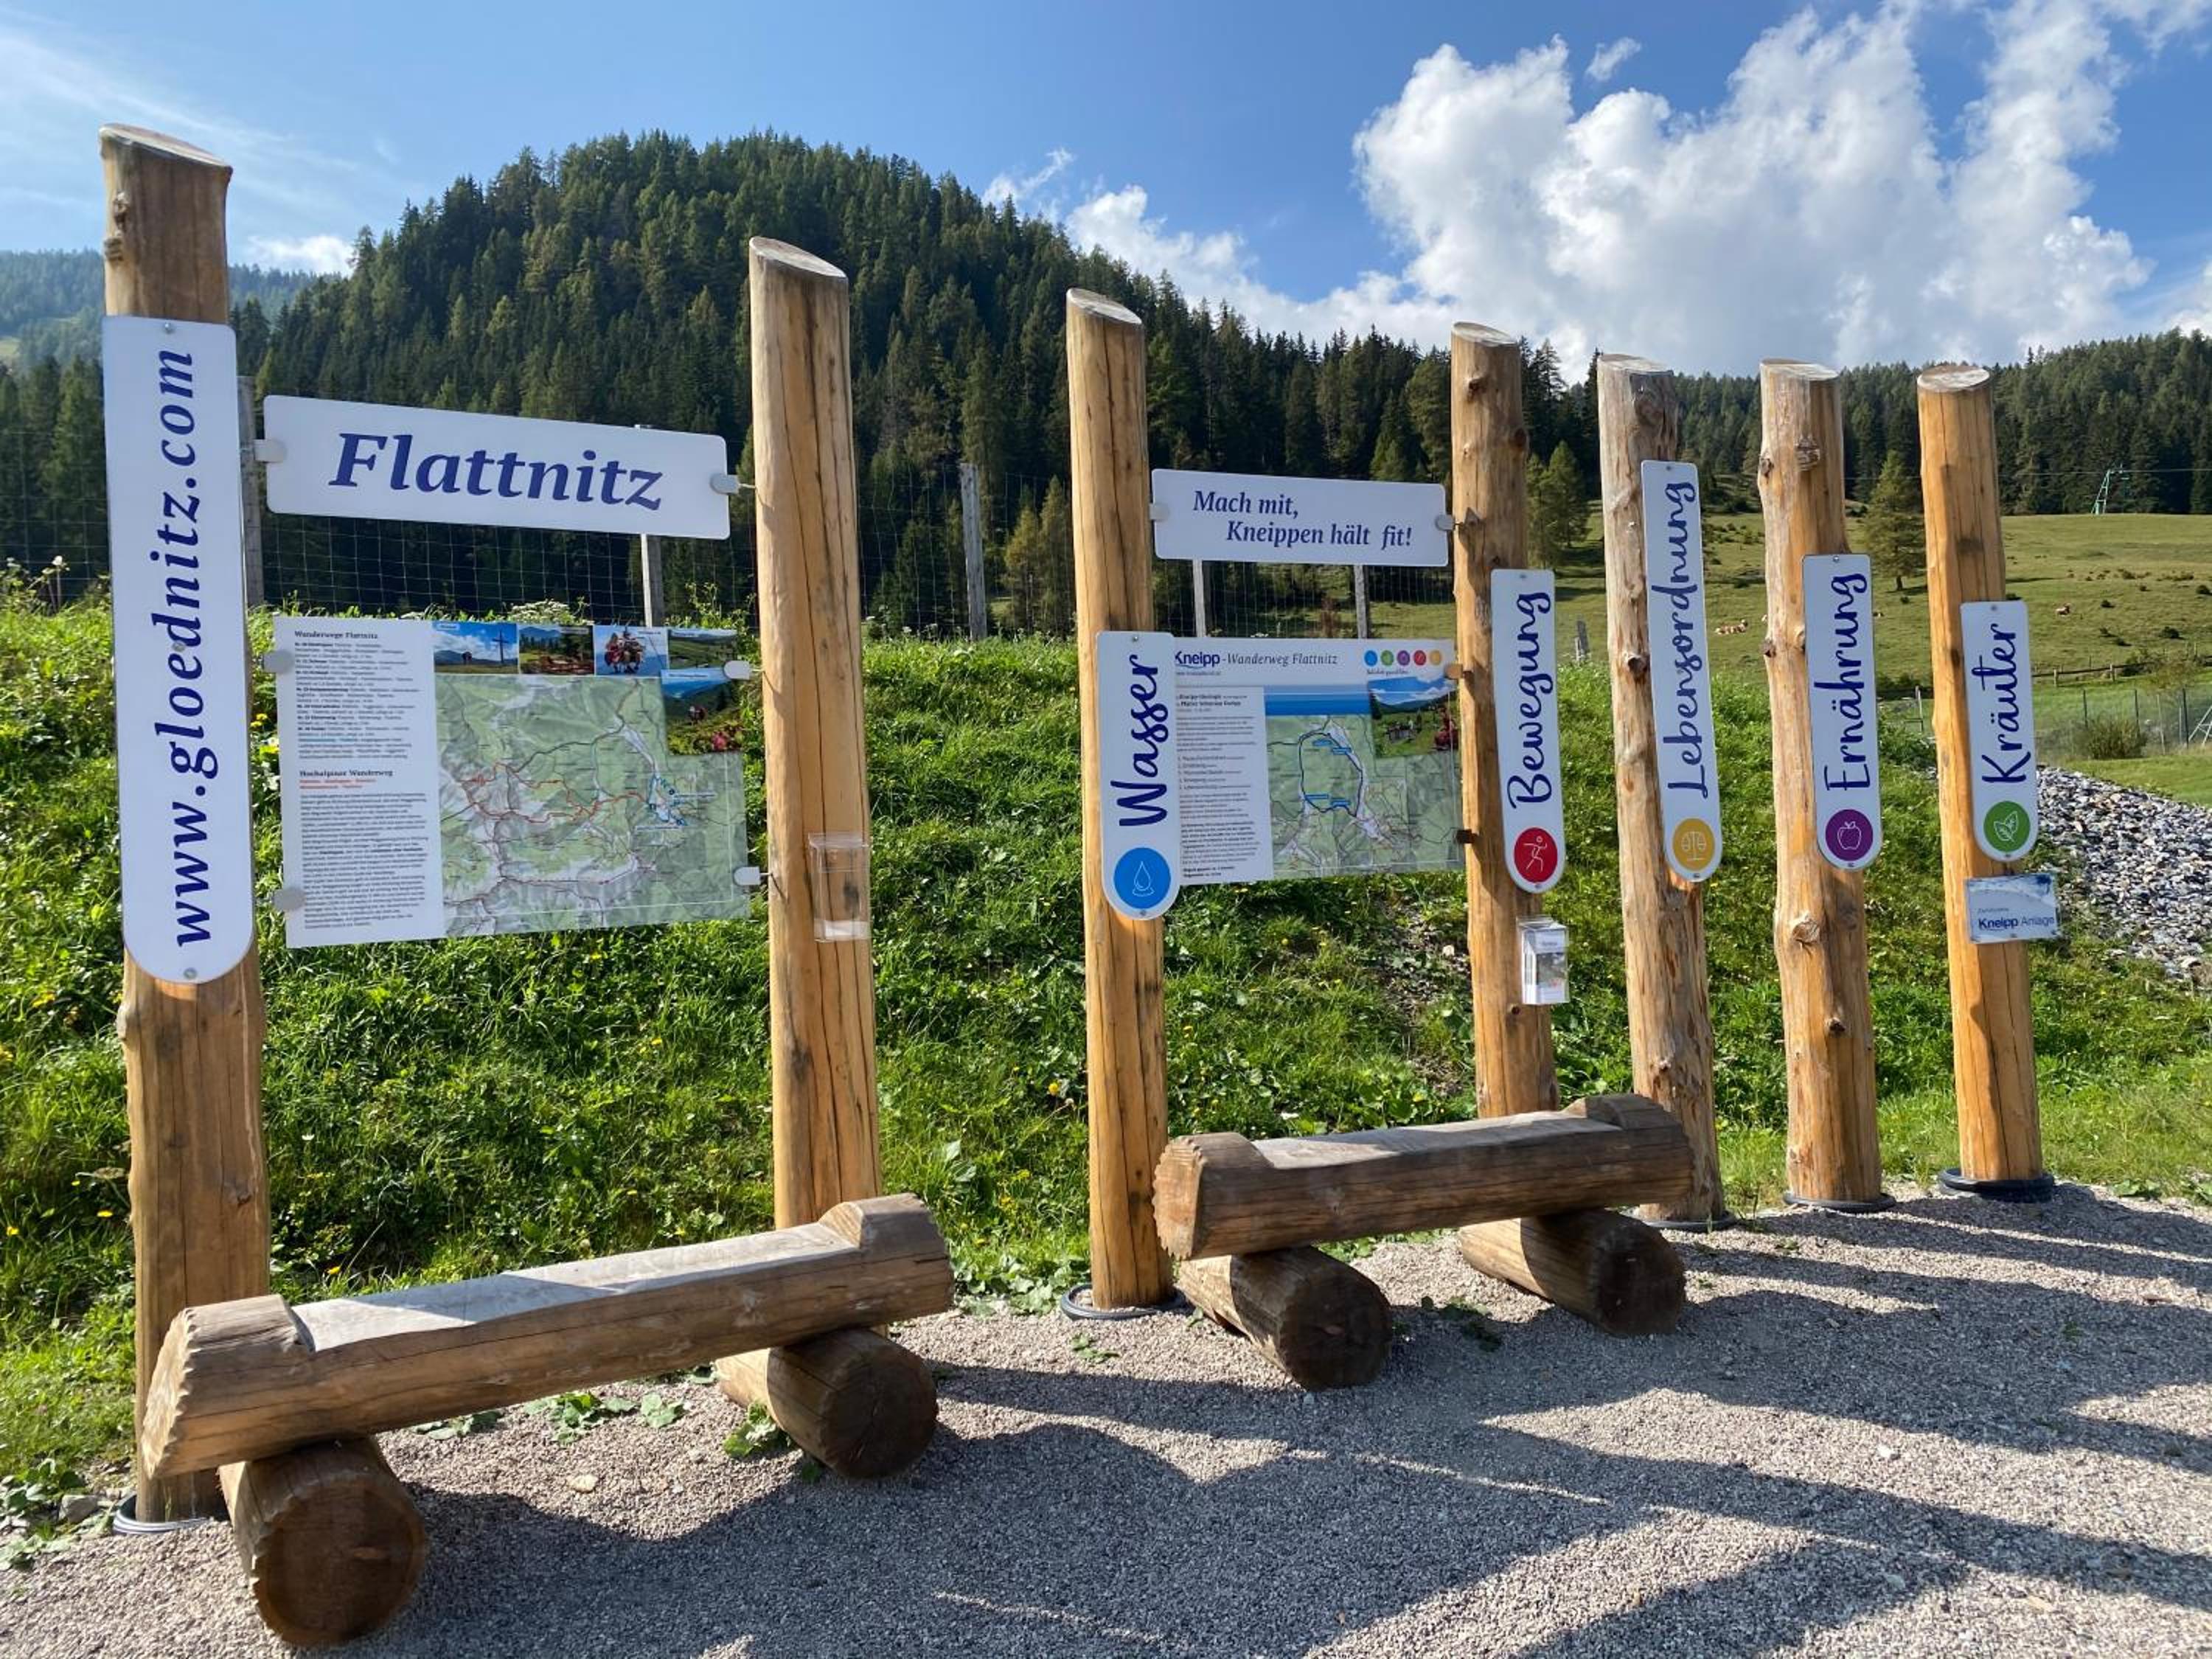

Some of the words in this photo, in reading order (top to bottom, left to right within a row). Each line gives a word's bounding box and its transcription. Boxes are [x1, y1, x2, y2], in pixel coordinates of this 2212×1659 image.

[328, 432, 663, 511] Flattnitz
[1192, 490, 1252, 514] Mach
[1258, 493, 1298, 520] mit,
[1225, 520, 1324, 549] Kneippen
[1329, 523, 1371, 546] hält
[1380, 524, 1413, 552] fit!
[150, 349, 219, 947] www.gloednitz.com
[1292, 653, 1338, 665] Flattnitz
[1506, 592, 1554, 810] Bewegung
[1651, 481, 1708, 799] Lebensordnung
[1813, 572, 1870, 791] Ernährung
[1971, 622, 2032, 785] Kräuter
[1110, 653, 1170, 827] Wasser
[1978, 917, 2019, 929] Kneipp
